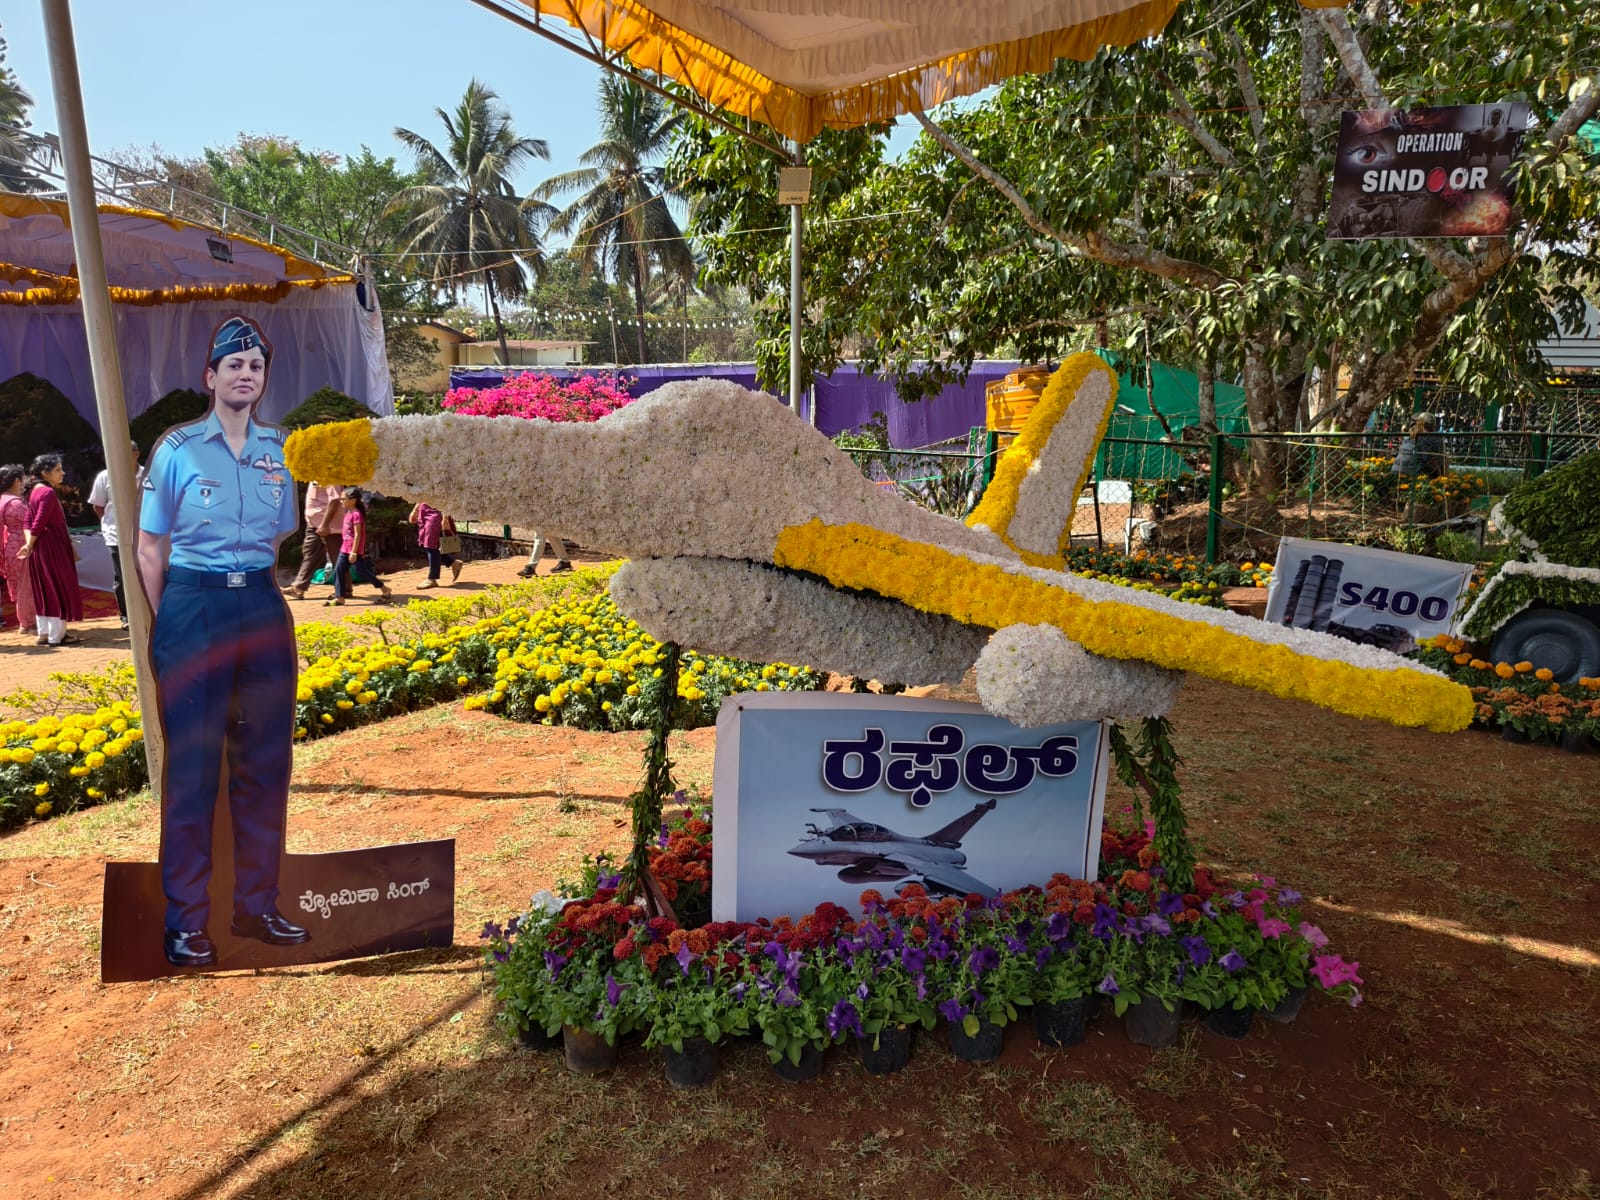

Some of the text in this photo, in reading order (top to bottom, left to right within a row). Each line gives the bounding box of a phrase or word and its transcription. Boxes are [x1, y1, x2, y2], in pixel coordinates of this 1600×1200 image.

[1397, 132, 1464, 153] OPERATION
[1339, 581, 1450, 622] S400
[823, 723, 1080, 808] ರಫೆಲ್
[299, 877, 431, 919] ವ್ಯೋಮಿಕಾ ಸಿಂಗ್
